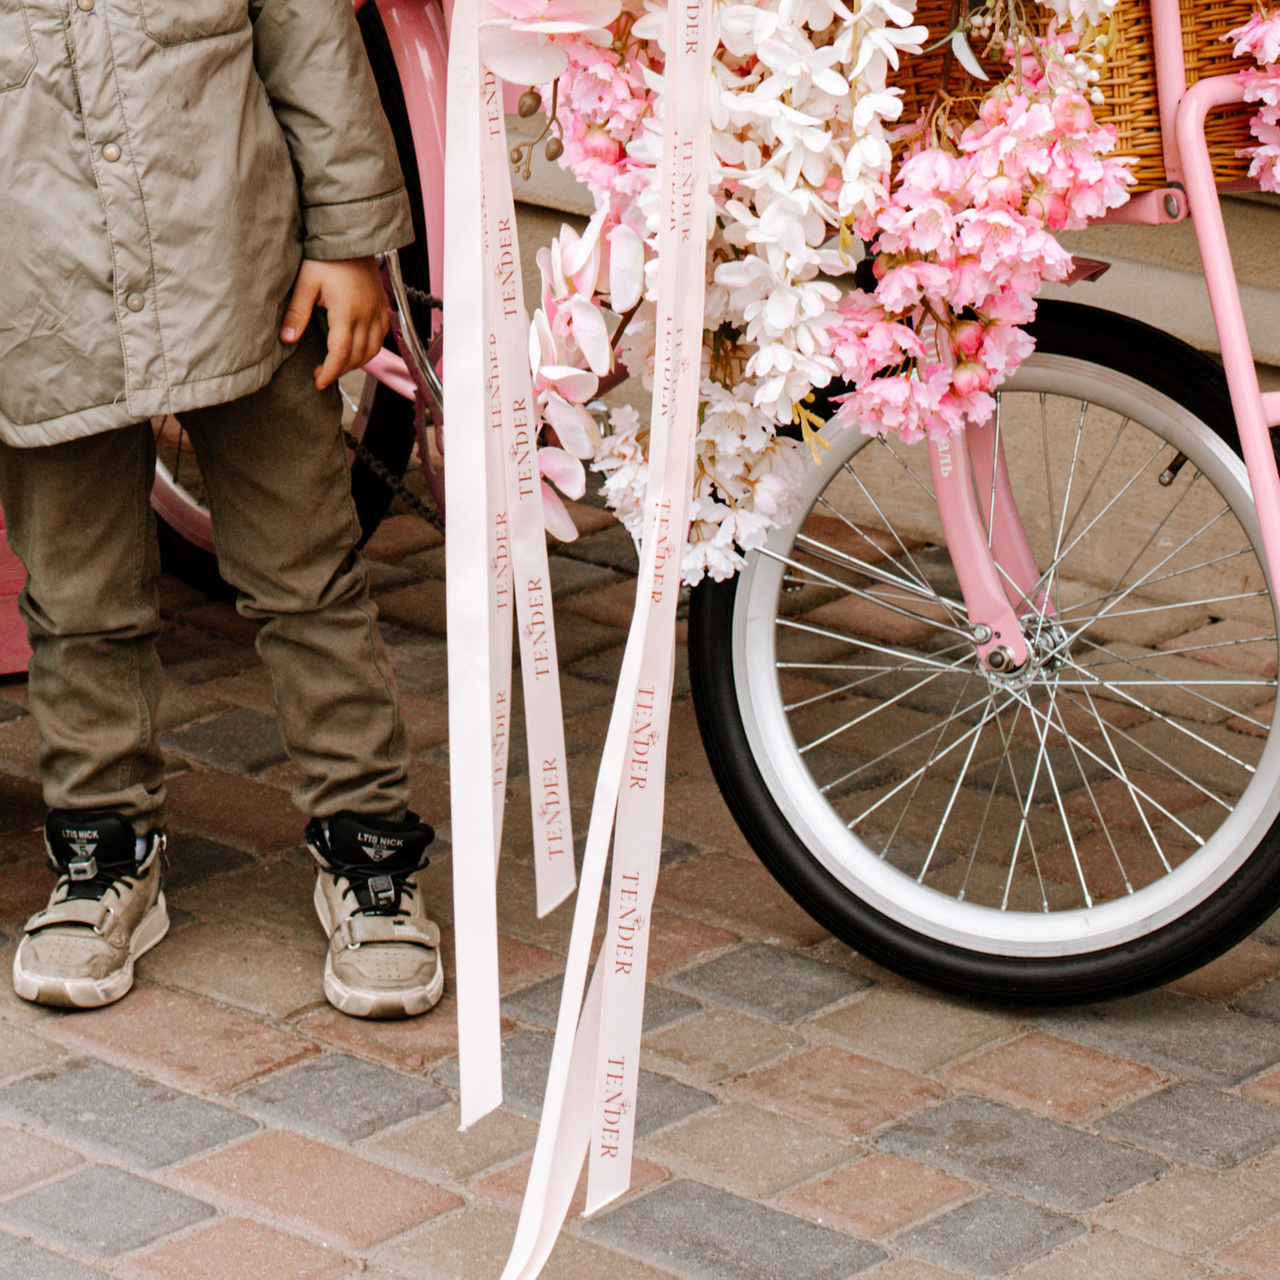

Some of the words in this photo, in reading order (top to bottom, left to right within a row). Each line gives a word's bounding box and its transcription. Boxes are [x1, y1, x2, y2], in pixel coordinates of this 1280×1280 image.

[484, 65, 501, 141] TEND
[498, 217, 518, 321] TENDER
[512, 397, 534, 501] TENDER
[495, 511, 509, 613] TENDER
[650, 499, 672, 605] TENDER
[528, 576, 551, 681] TENDER
[493, 689, 507, 792] TENDER
[629, 685, 656, 791] TENDER
[379, 837, 404, 848] NICK
[542, 756, 565, 861] TENDER
[614, 870, 640, 975] TENDER
[600, 1055, 626, 1159] TENDER
